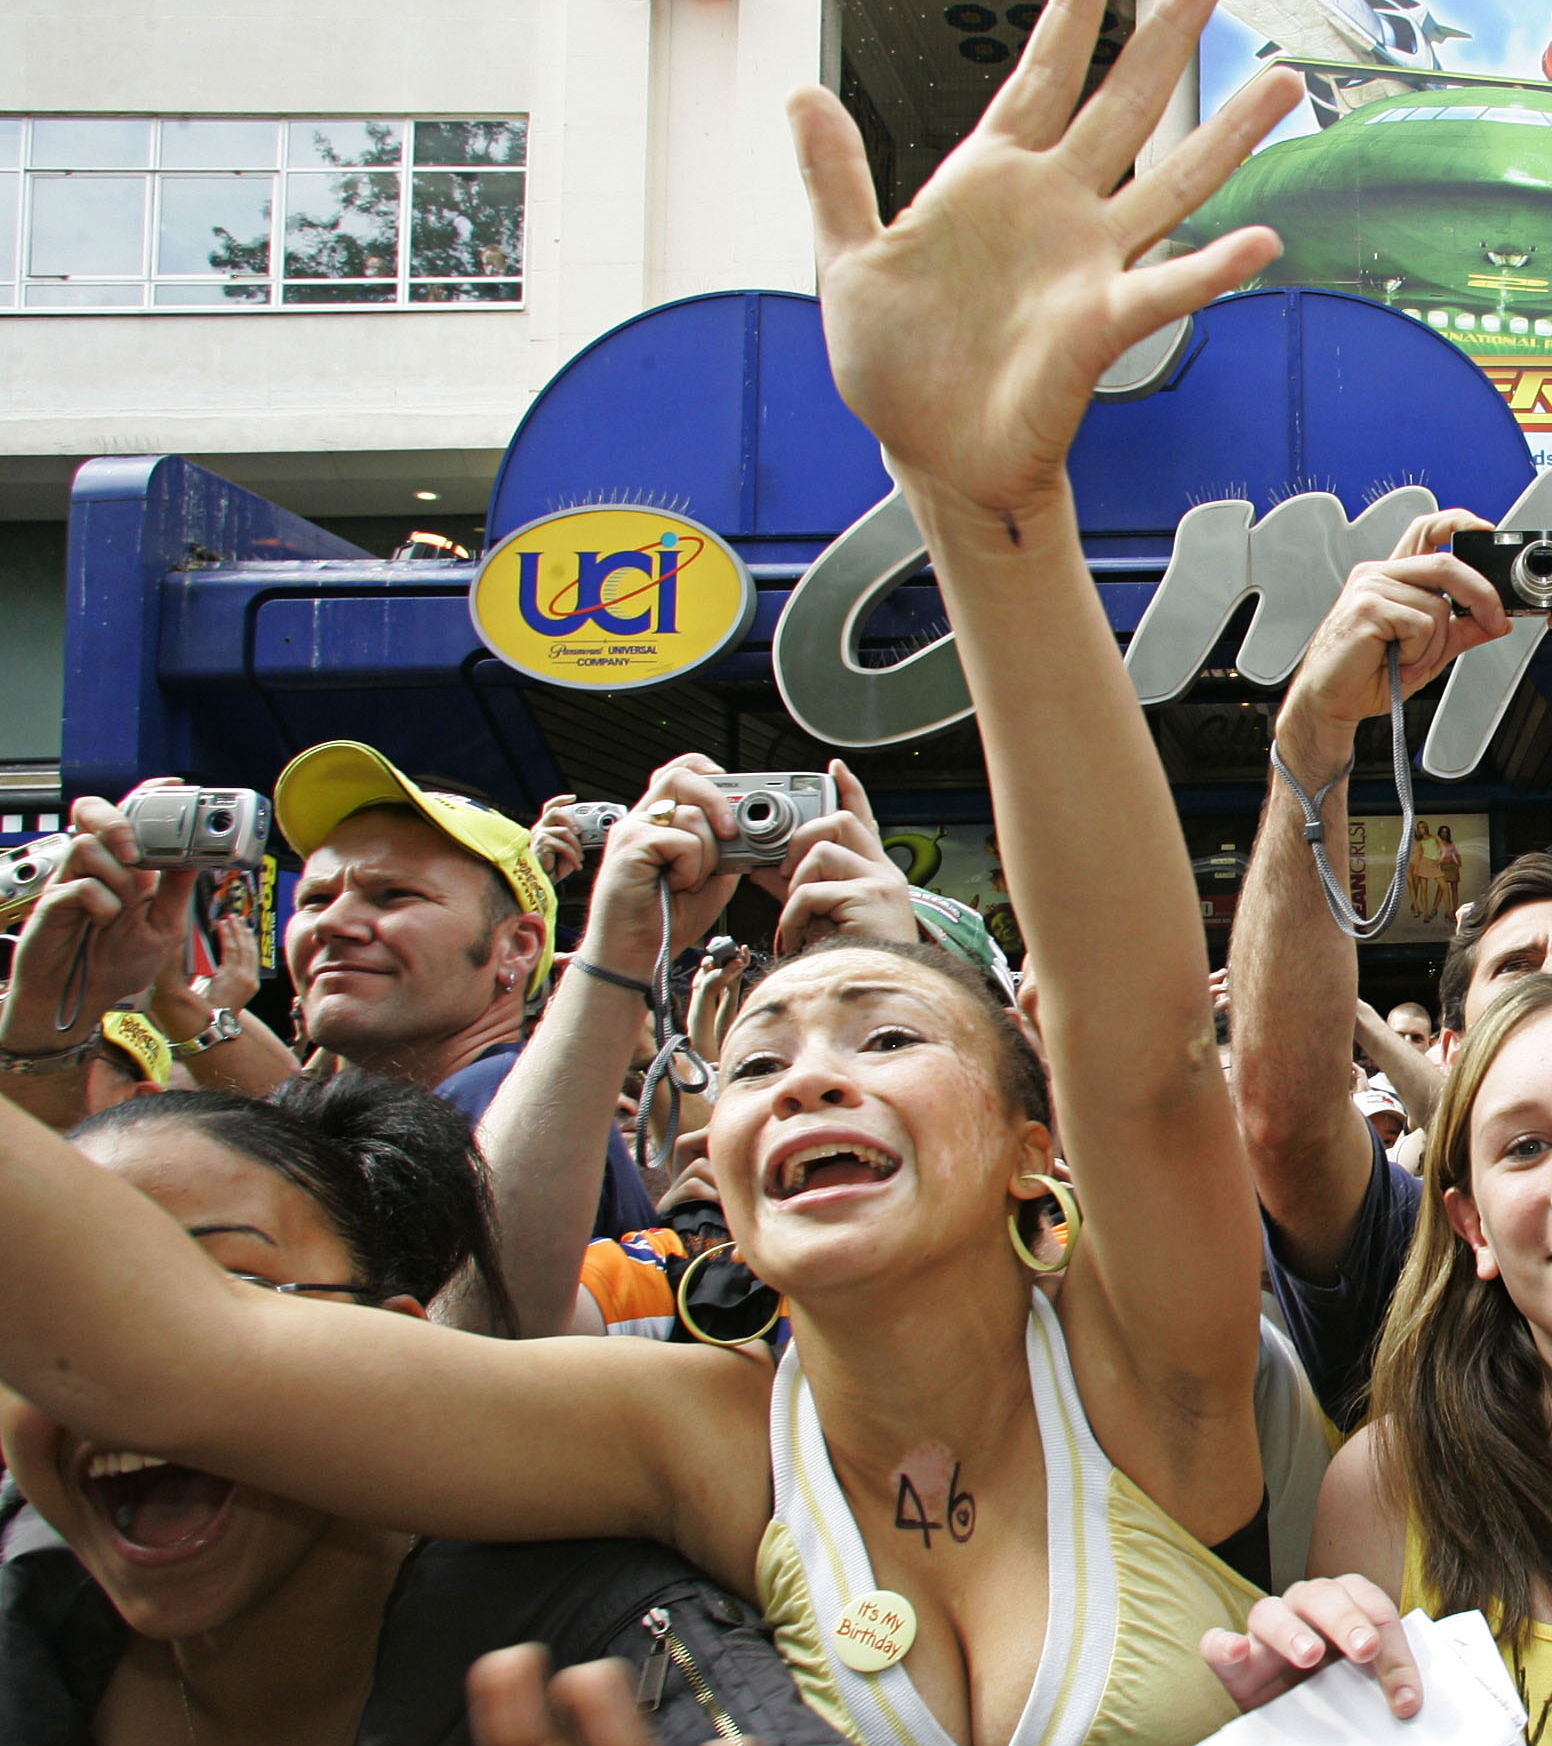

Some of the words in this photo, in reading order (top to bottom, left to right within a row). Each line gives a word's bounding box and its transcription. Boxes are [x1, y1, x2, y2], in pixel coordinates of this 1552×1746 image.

[576, 658, 631, 667] COMPANY
[608, 646, 658, 655] UNIVERSAL
[895, 1461, 976, 1549] 46
[857, 1601, 880, 1622] It's
[880, 1612, 904, 1635] My
[836, 1618, 902, 1660] Birthday
